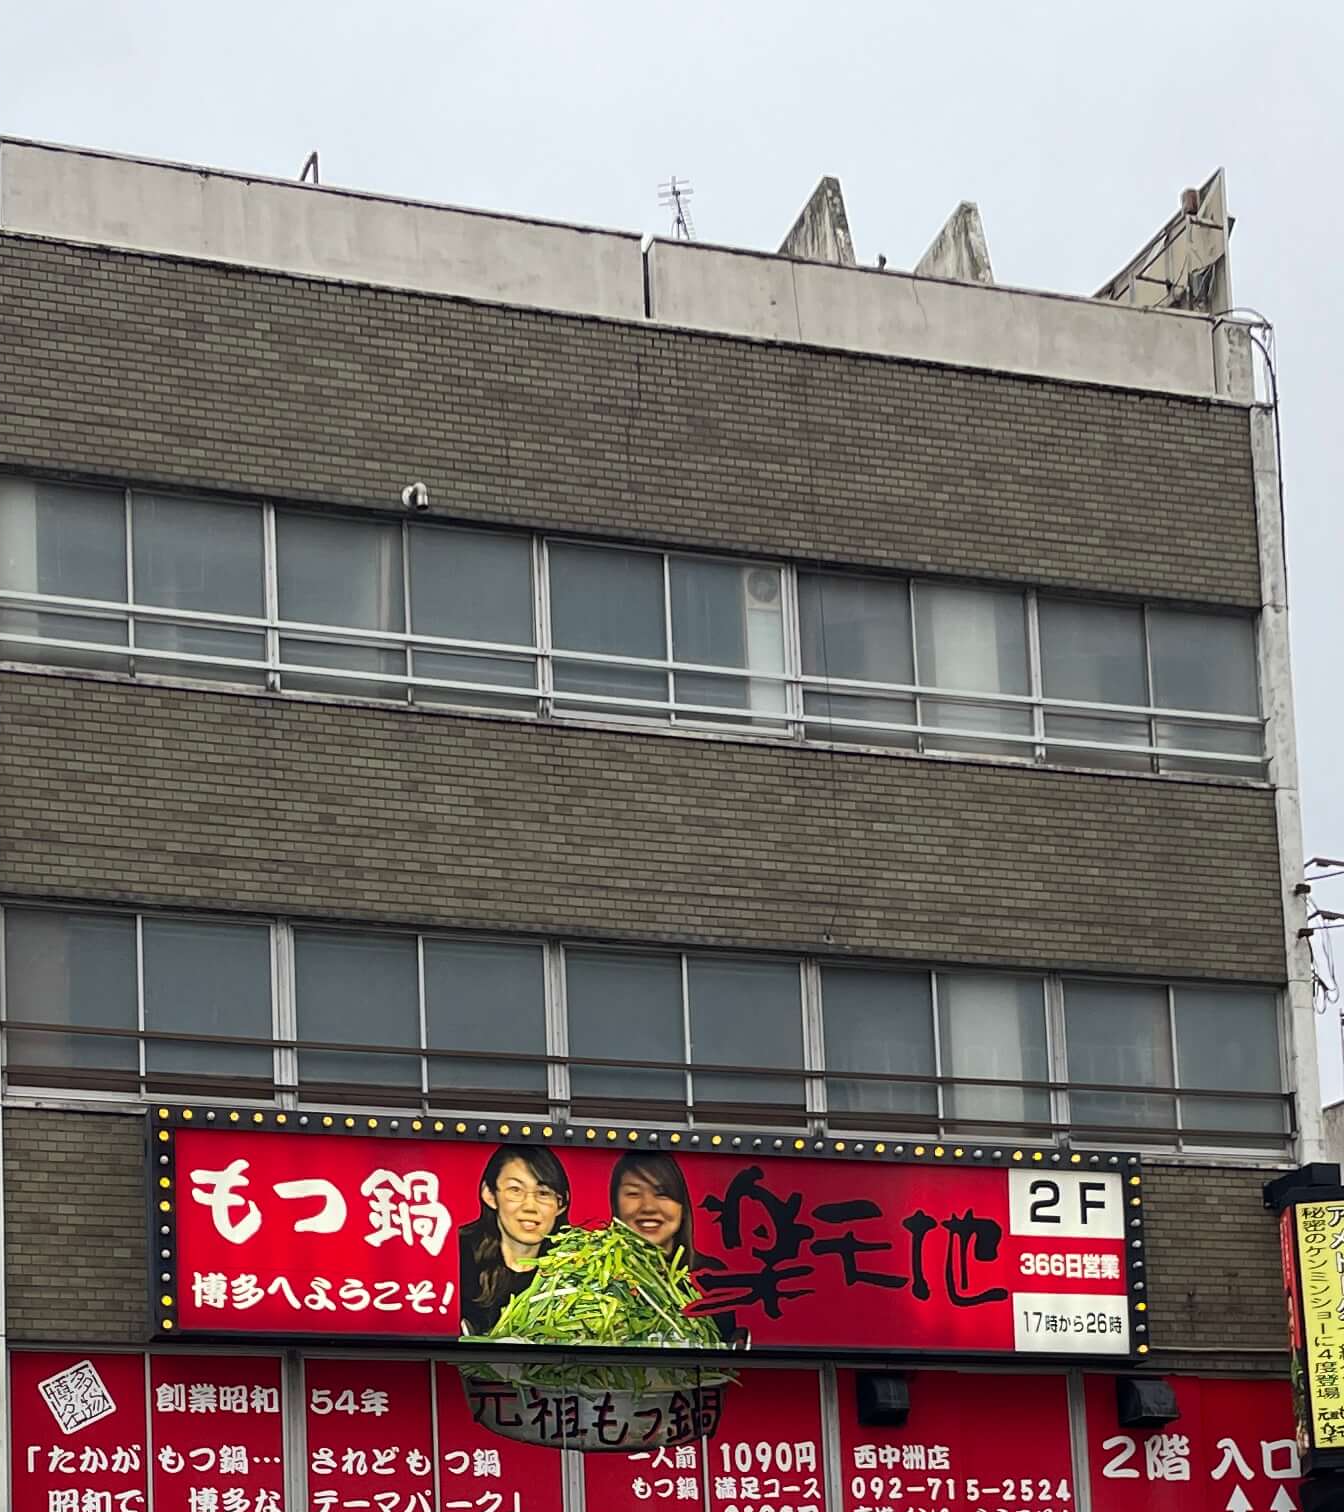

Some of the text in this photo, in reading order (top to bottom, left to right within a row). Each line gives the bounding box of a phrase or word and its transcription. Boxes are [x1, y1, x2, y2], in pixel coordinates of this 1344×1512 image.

[189, 1158, 453, 1257] もつ鍋
[1020, 1252, 1120, 1281] 366日営業
[1023, 1311, 1123, 1335] 17時から26時
[470, 1379, 723, 1446] 元祖もつ鍋
[627, 1445, 697, 1470] 一人前
[719, 1441, 816, 1473] 1090円
[854, 1444, 950, 1471] 西中洲店
[631, 1476, 698, 1501] もつ鍋
[715, 1477, 822, 1500] 満足コース
